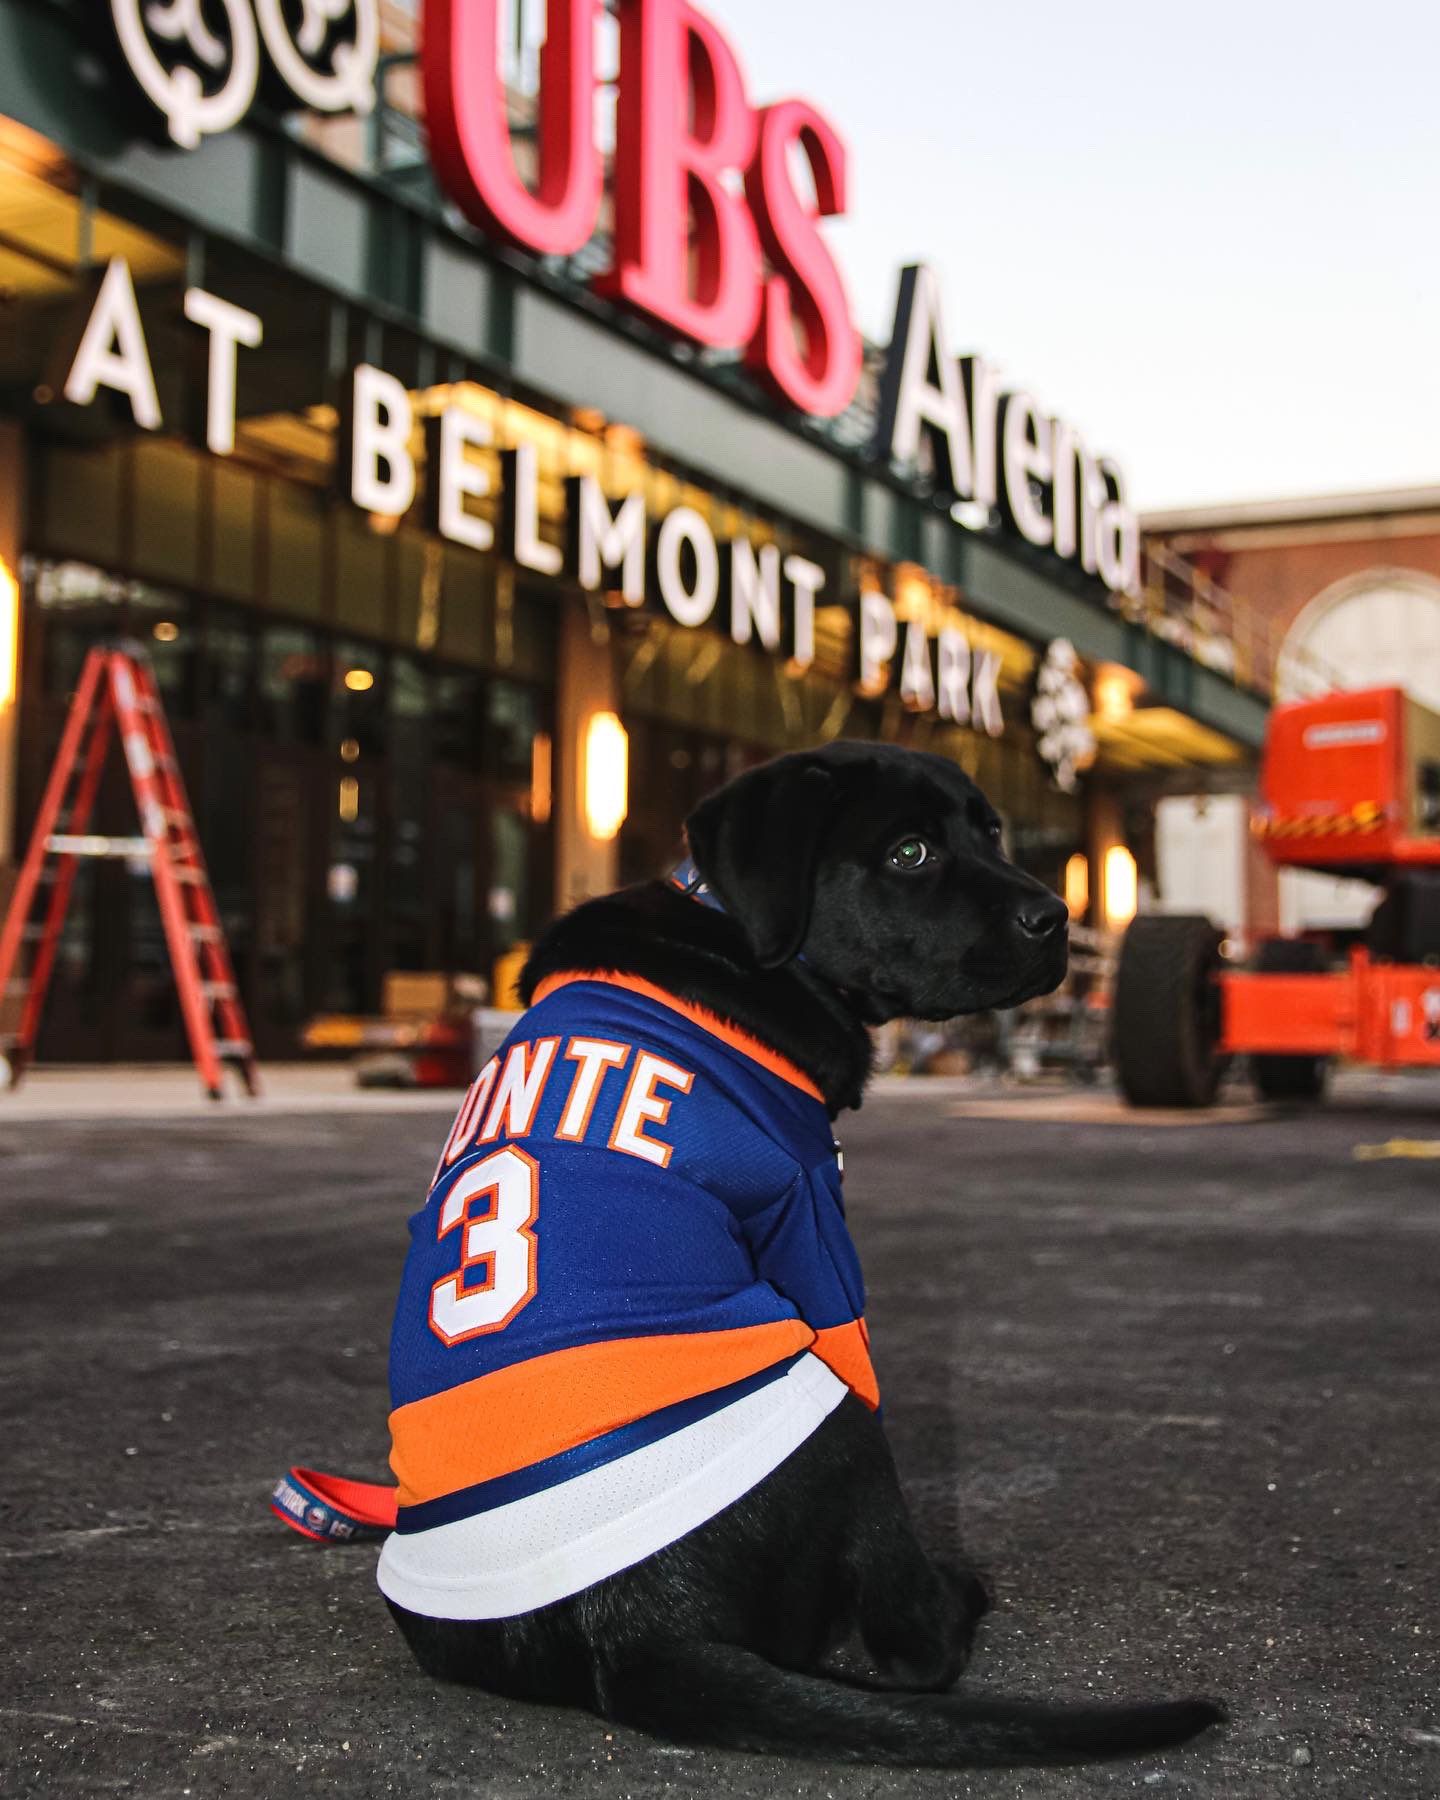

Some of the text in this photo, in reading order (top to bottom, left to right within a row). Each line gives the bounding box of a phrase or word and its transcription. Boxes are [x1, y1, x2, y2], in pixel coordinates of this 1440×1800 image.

[422, 0, 1140, 596] UBS Arena
[64, 255, 1005, 737] AT BELMONT PARK
[428, 1144, 539, 1347] 3
[430, 1036, 696, 1190] ONTE
